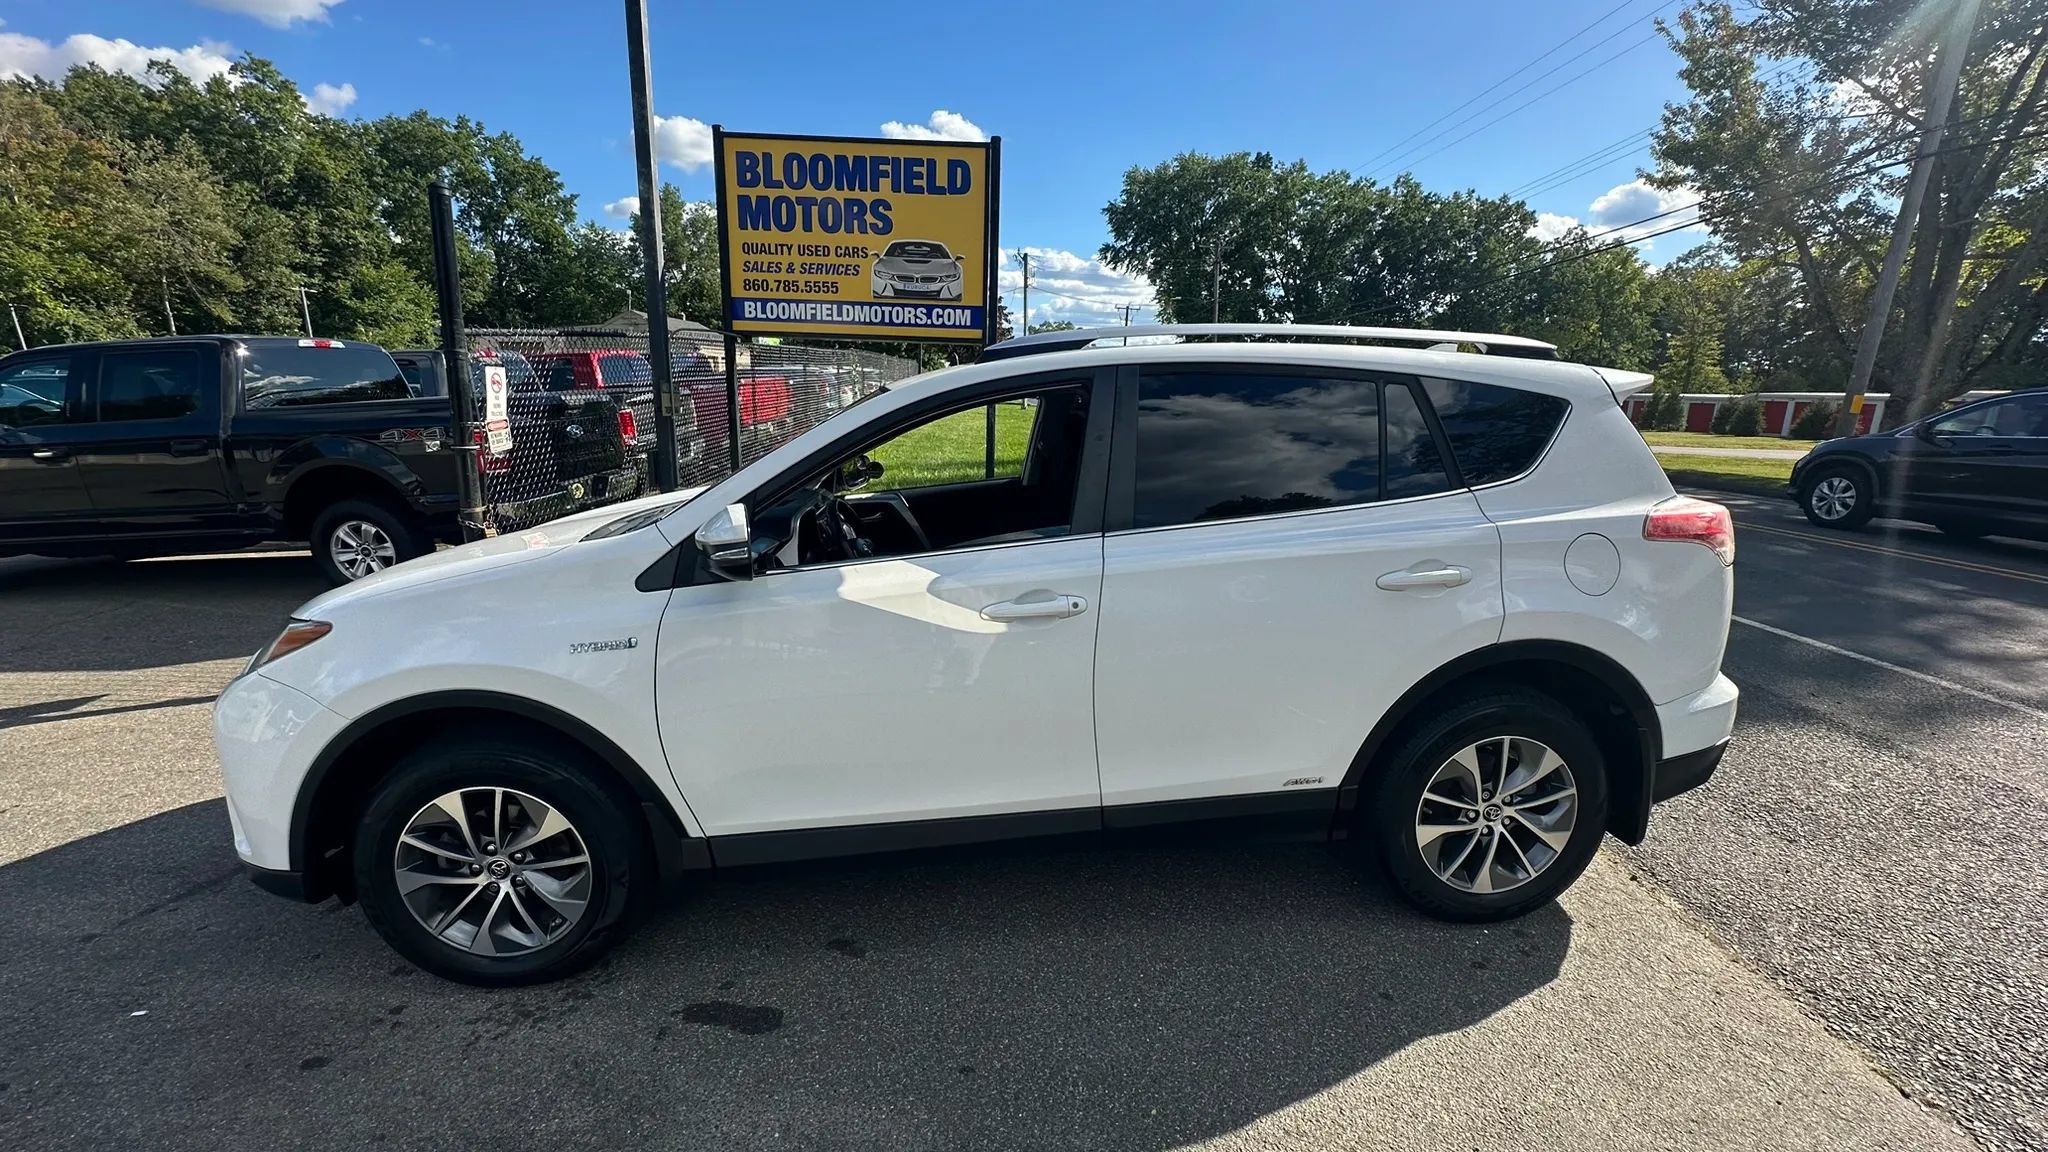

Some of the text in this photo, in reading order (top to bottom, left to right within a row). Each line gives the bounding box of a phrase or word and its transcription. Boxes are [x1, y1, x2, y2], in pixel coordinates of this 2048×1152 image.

[735, 151, 972, 196] BLOOMFIELD
[737, 195, 894, 236] MOTORS
[742, 241, 869, 259] QUALITY USED CARS
[742, 260, 860, 277] SALES & SERVICES
[743, 278, 839, 294] 860.785.5555
[744, 300, 972, 327] BLOOMFIELDMOTORS.COM
